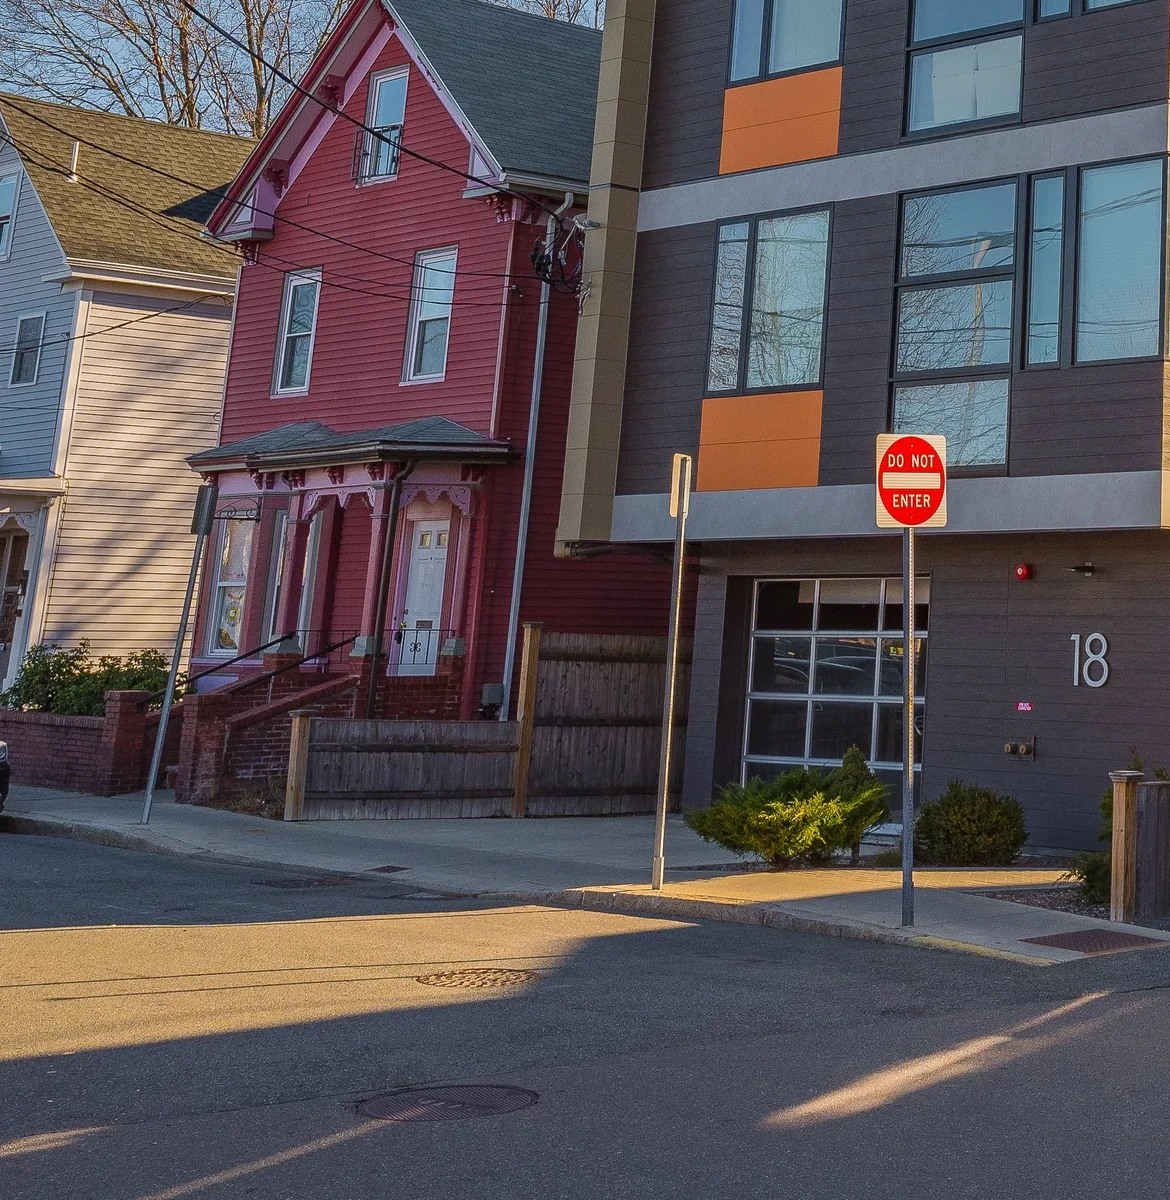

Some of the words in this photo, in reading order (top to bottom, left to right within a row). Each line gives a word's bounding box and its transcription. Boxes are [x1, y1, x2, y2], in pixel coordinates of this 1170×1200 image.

[888, 454, 904, 467] DO
[912, 454, 934, 467] NOT
[893, 494, 931, 508] ENTER
[1070, 632, 1109, 688] 18
